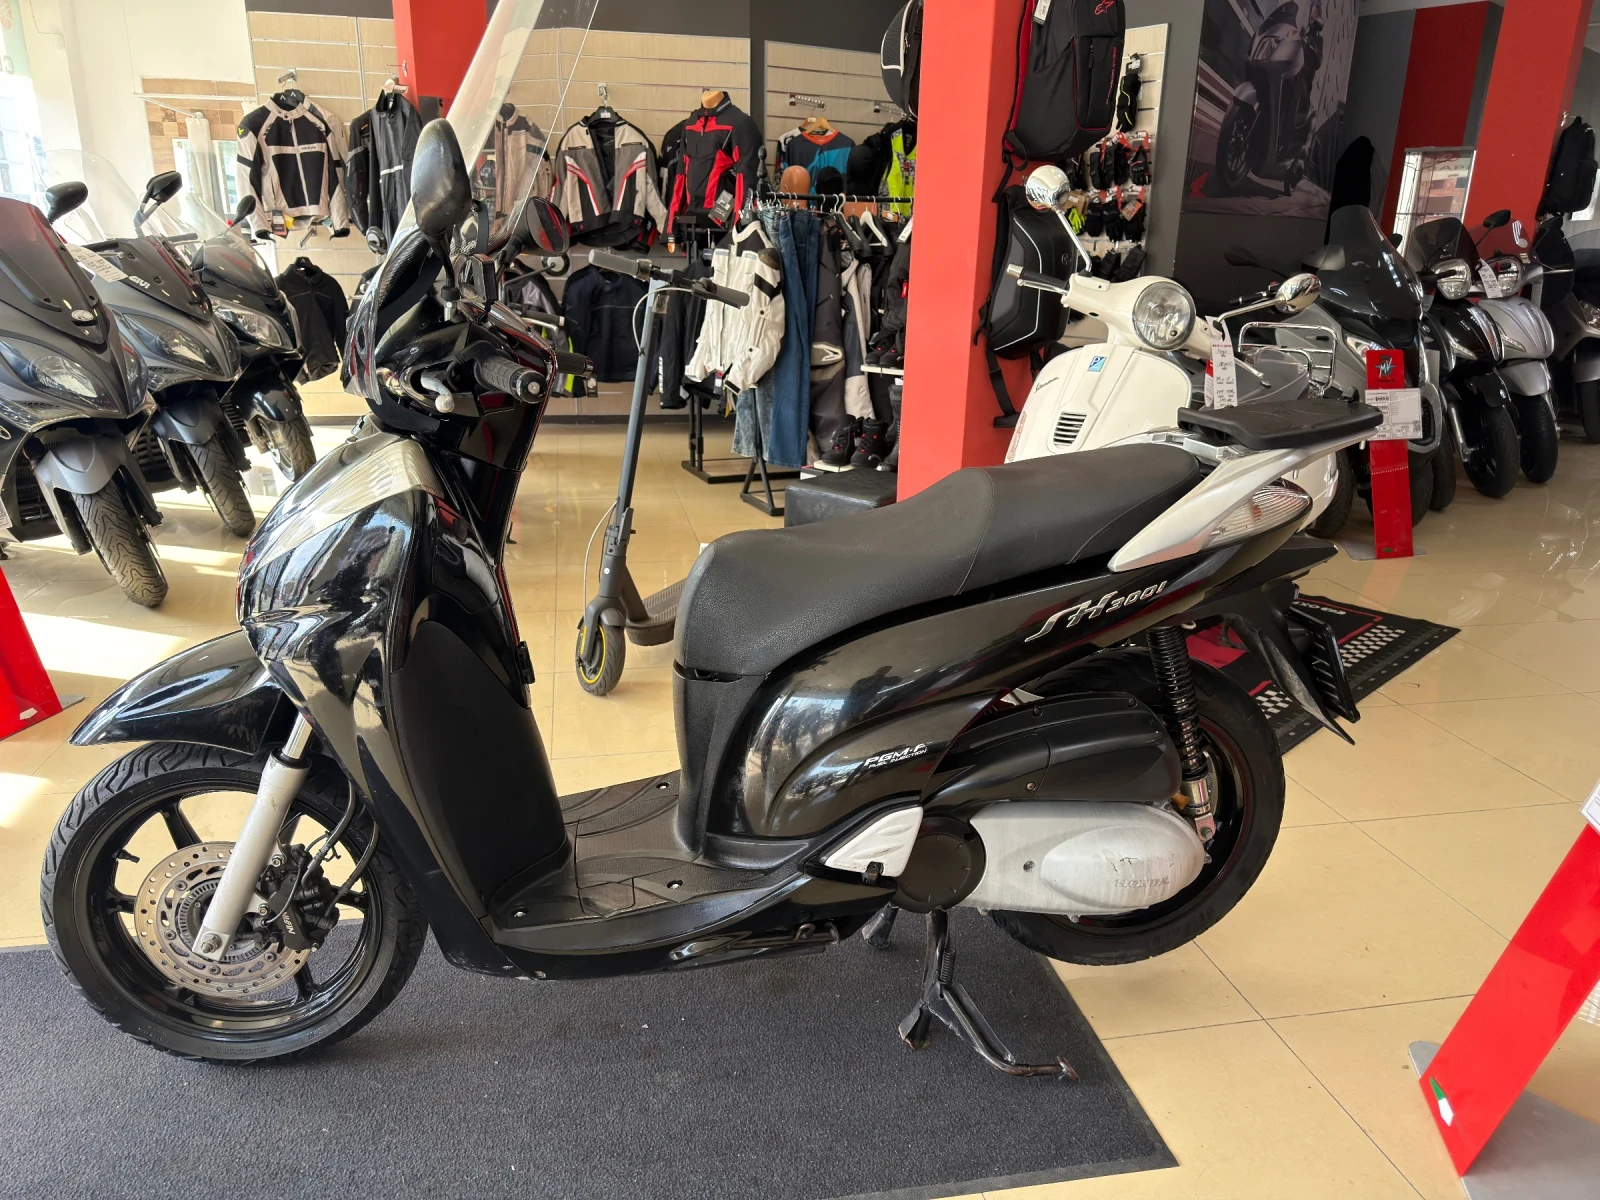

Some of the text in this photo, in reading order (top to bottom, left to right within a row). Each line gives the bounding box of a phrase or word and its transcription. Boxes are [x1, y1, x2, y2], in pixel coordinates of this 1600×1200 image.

[128, 275, 151, 290] GIVI
[890, 748, 928, 763] INJECTION
[1114, 877, 1170, 888] HONDA
